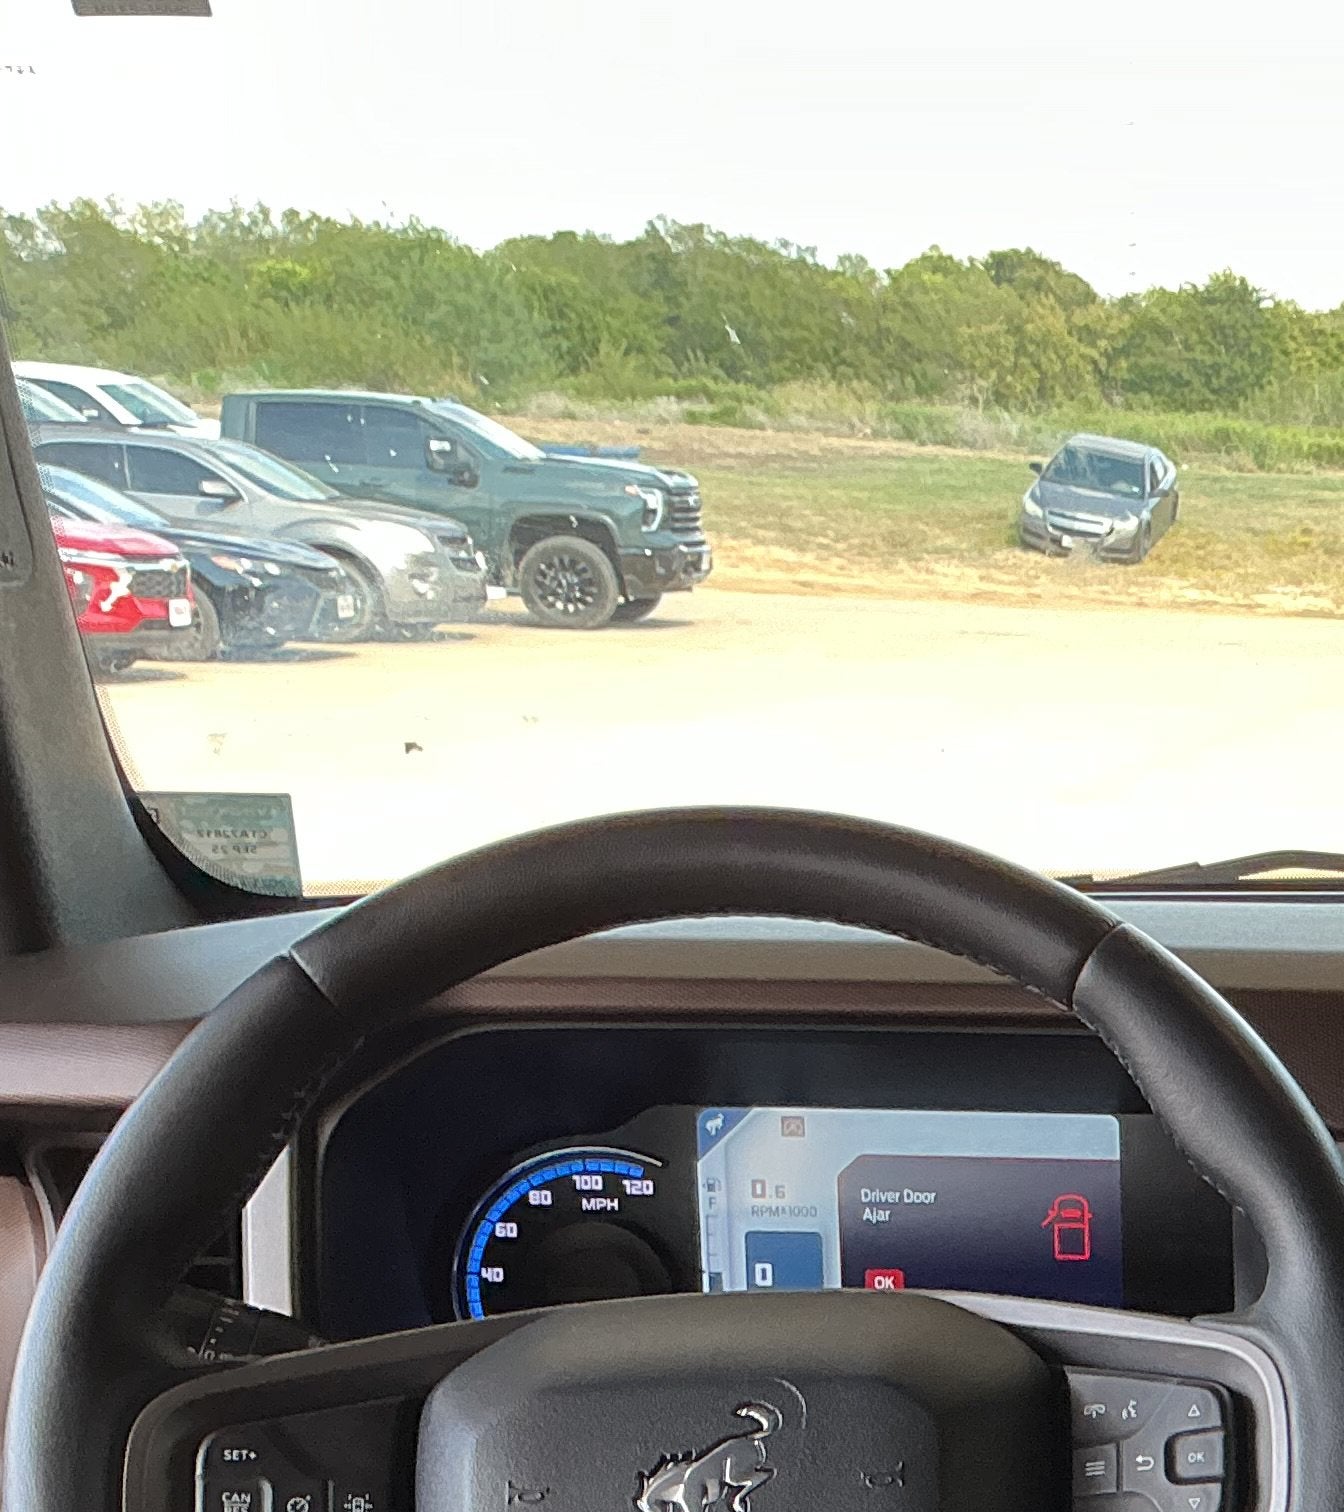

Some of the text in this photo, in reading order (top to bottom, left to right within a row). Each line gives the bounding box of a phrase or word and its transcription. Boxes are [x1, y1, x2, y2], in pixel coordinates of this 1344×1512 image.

[572, 1175, 603, 1191] 100
[623, 1179, 654, 1196] 120
[529, 1190, 552, 1206] 80
[861, 1188, 936, 1204] Driver Door
[581, 1197, 619, 1212] MPH
[862, 1207, 891, 1223] Ajar
[494, 1222, 517, 1238] 60
[481, 1267, 504, 1282] 40
[754, 1263, 773, 1287] 0
[873, 1275, 895, 1290] OK
[1187, 1451, 1205, 1463] OK
[222, 1491, 251, 1505] CAN
